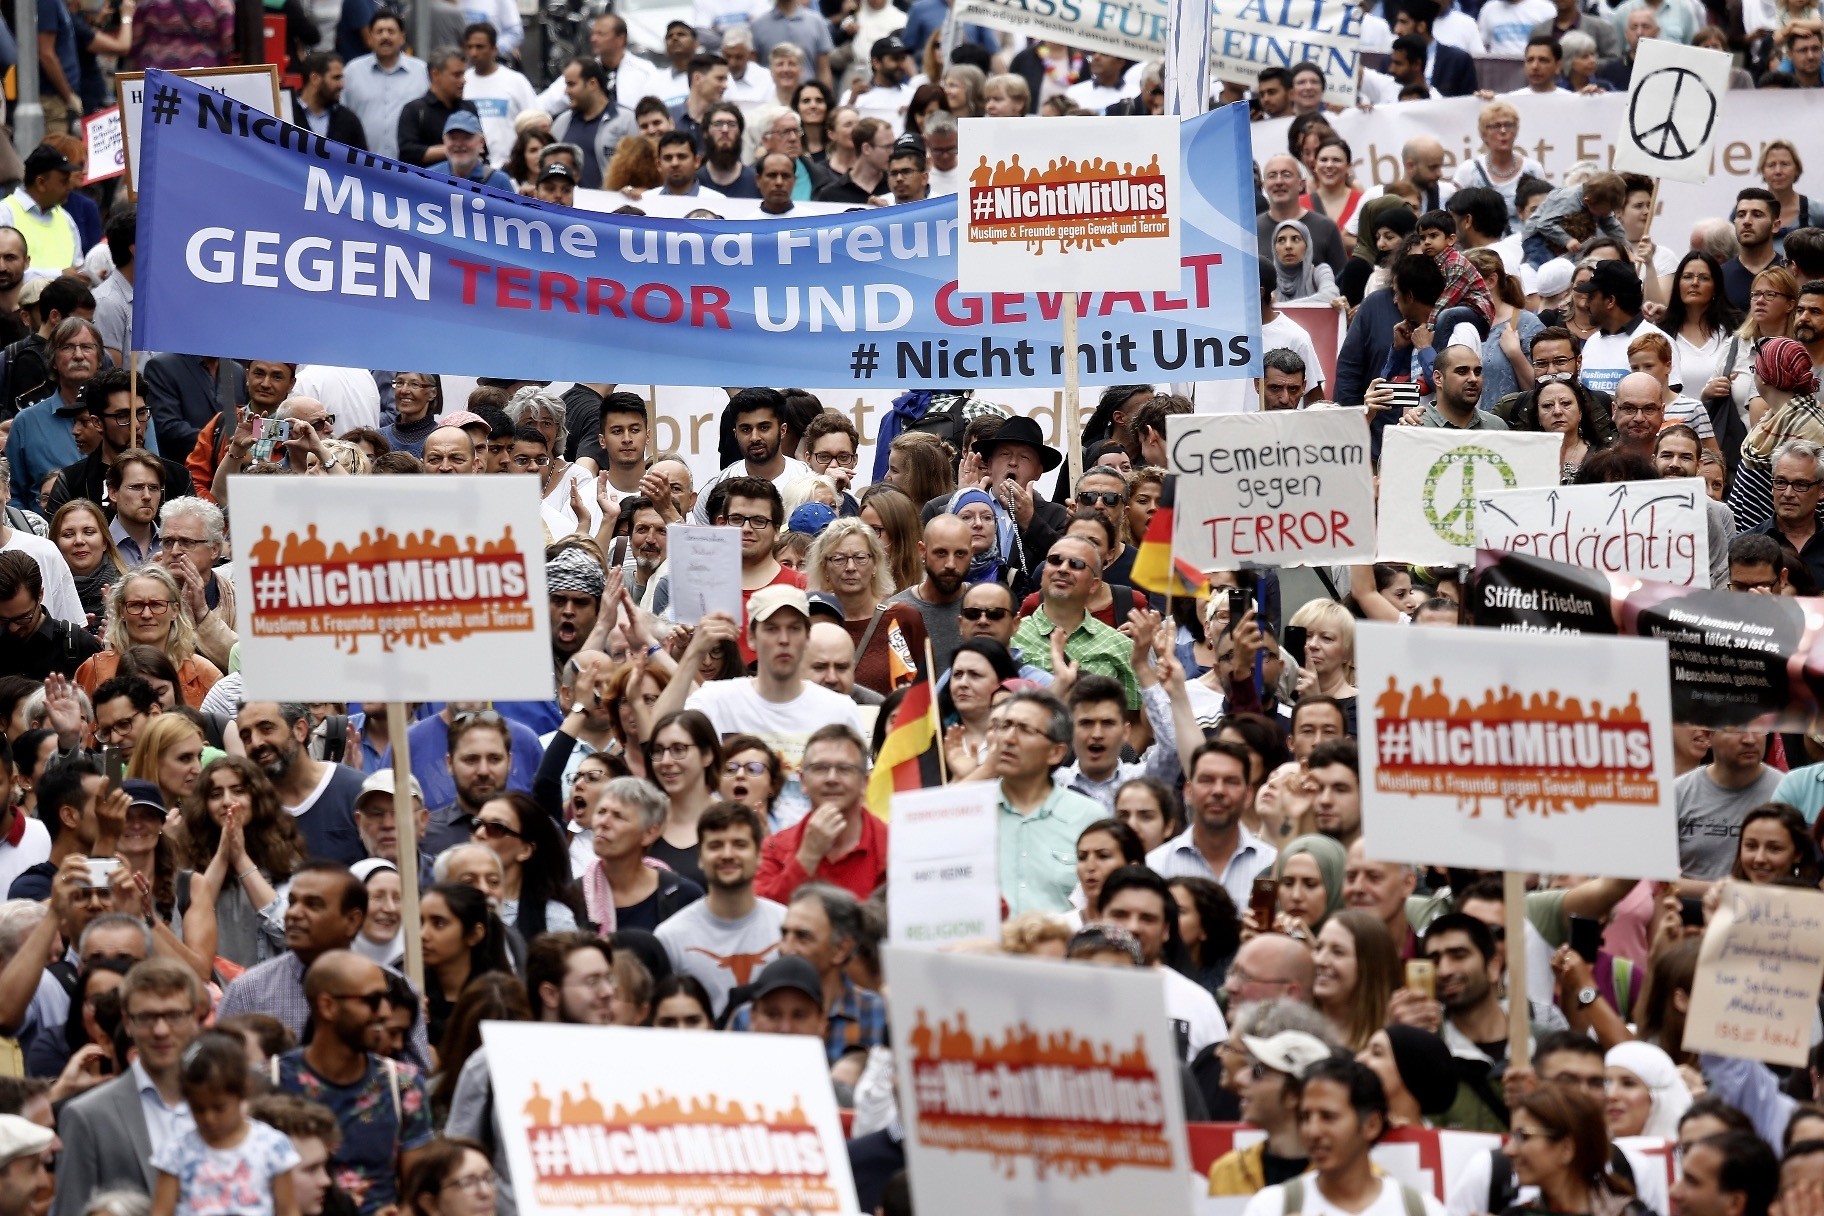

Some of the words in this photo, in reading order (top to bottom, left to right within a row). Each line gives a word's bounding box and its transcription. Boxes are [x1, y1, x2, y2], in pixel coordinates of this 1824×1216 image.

[1211, 27, 1360, 78] EINEN
[304, 165, 598, 259] Muslime
[619, 229, 753, 266] und
[972, 179, 1165, 221] #NichtMitUns
[970, 226, 1008, 240] Muslime
[1010, 227, 1018, 238] &
[1019, 223, 1055, 238] Freunde
[1058, 224, 1086, 239] gegen
[1088, 222, 1118, 235] Gewalt
[1119, 222, 1137, 234] und
[1139, 220, 1167, 233] Terror
[185, 226, 432, 301] GEGEN
[448, 258, 732, 330] TERROR
[753, 283, 914, 333] UND
[896, 336, 1035, 379] Nicht
[1050, 330, 1138, 375] mit
[1153, 328, 1252, 371] Uns
[1172, 429, 1363, 476] Gemeinsam
[1237, 475, 1321, 509] gegen
[1202, 510, 1355, 559] TERROR
[255, 557, 527, 609] #NichtMitUns
[1484, 584, 1538, 611] Stiftet
[1541, 589, 1595, 617] Frieden
[254, 615, 308, 635] Muslime
[311, 617, 321, 633] &
[323, 614, 375, 632] Freunde
[378, 613, 416, 635] gegen
[419, 611, 462, 630] Gewalt
[465, 610, 489, 628] und
[492, 609, 530, 627] Terror
[1669, 608, 1700, 623] Wenn
[1698, 615, 1744, 632] jemand
[1741, 621, 1775, 637] einen
[1704, 632, 1733, 650] tötet,
[1733, 637, 1749, 649] so
[1748, 638, 1765, 651] ist
[1379, 718, 1652, 769] #NichtMitUns
[1378, 771, 1429, 792] Muslime
[1446, 774, 1498, 793] Freunde
[1501, 778, 1538, 797] gegen
[1542, 777, 1584, 799] Gewalt
[1588, 780, 1613, 798] und
[1617, 781, 1655, 799] Terror
[531, 1123, 827, 1177] #NichtMitUns
